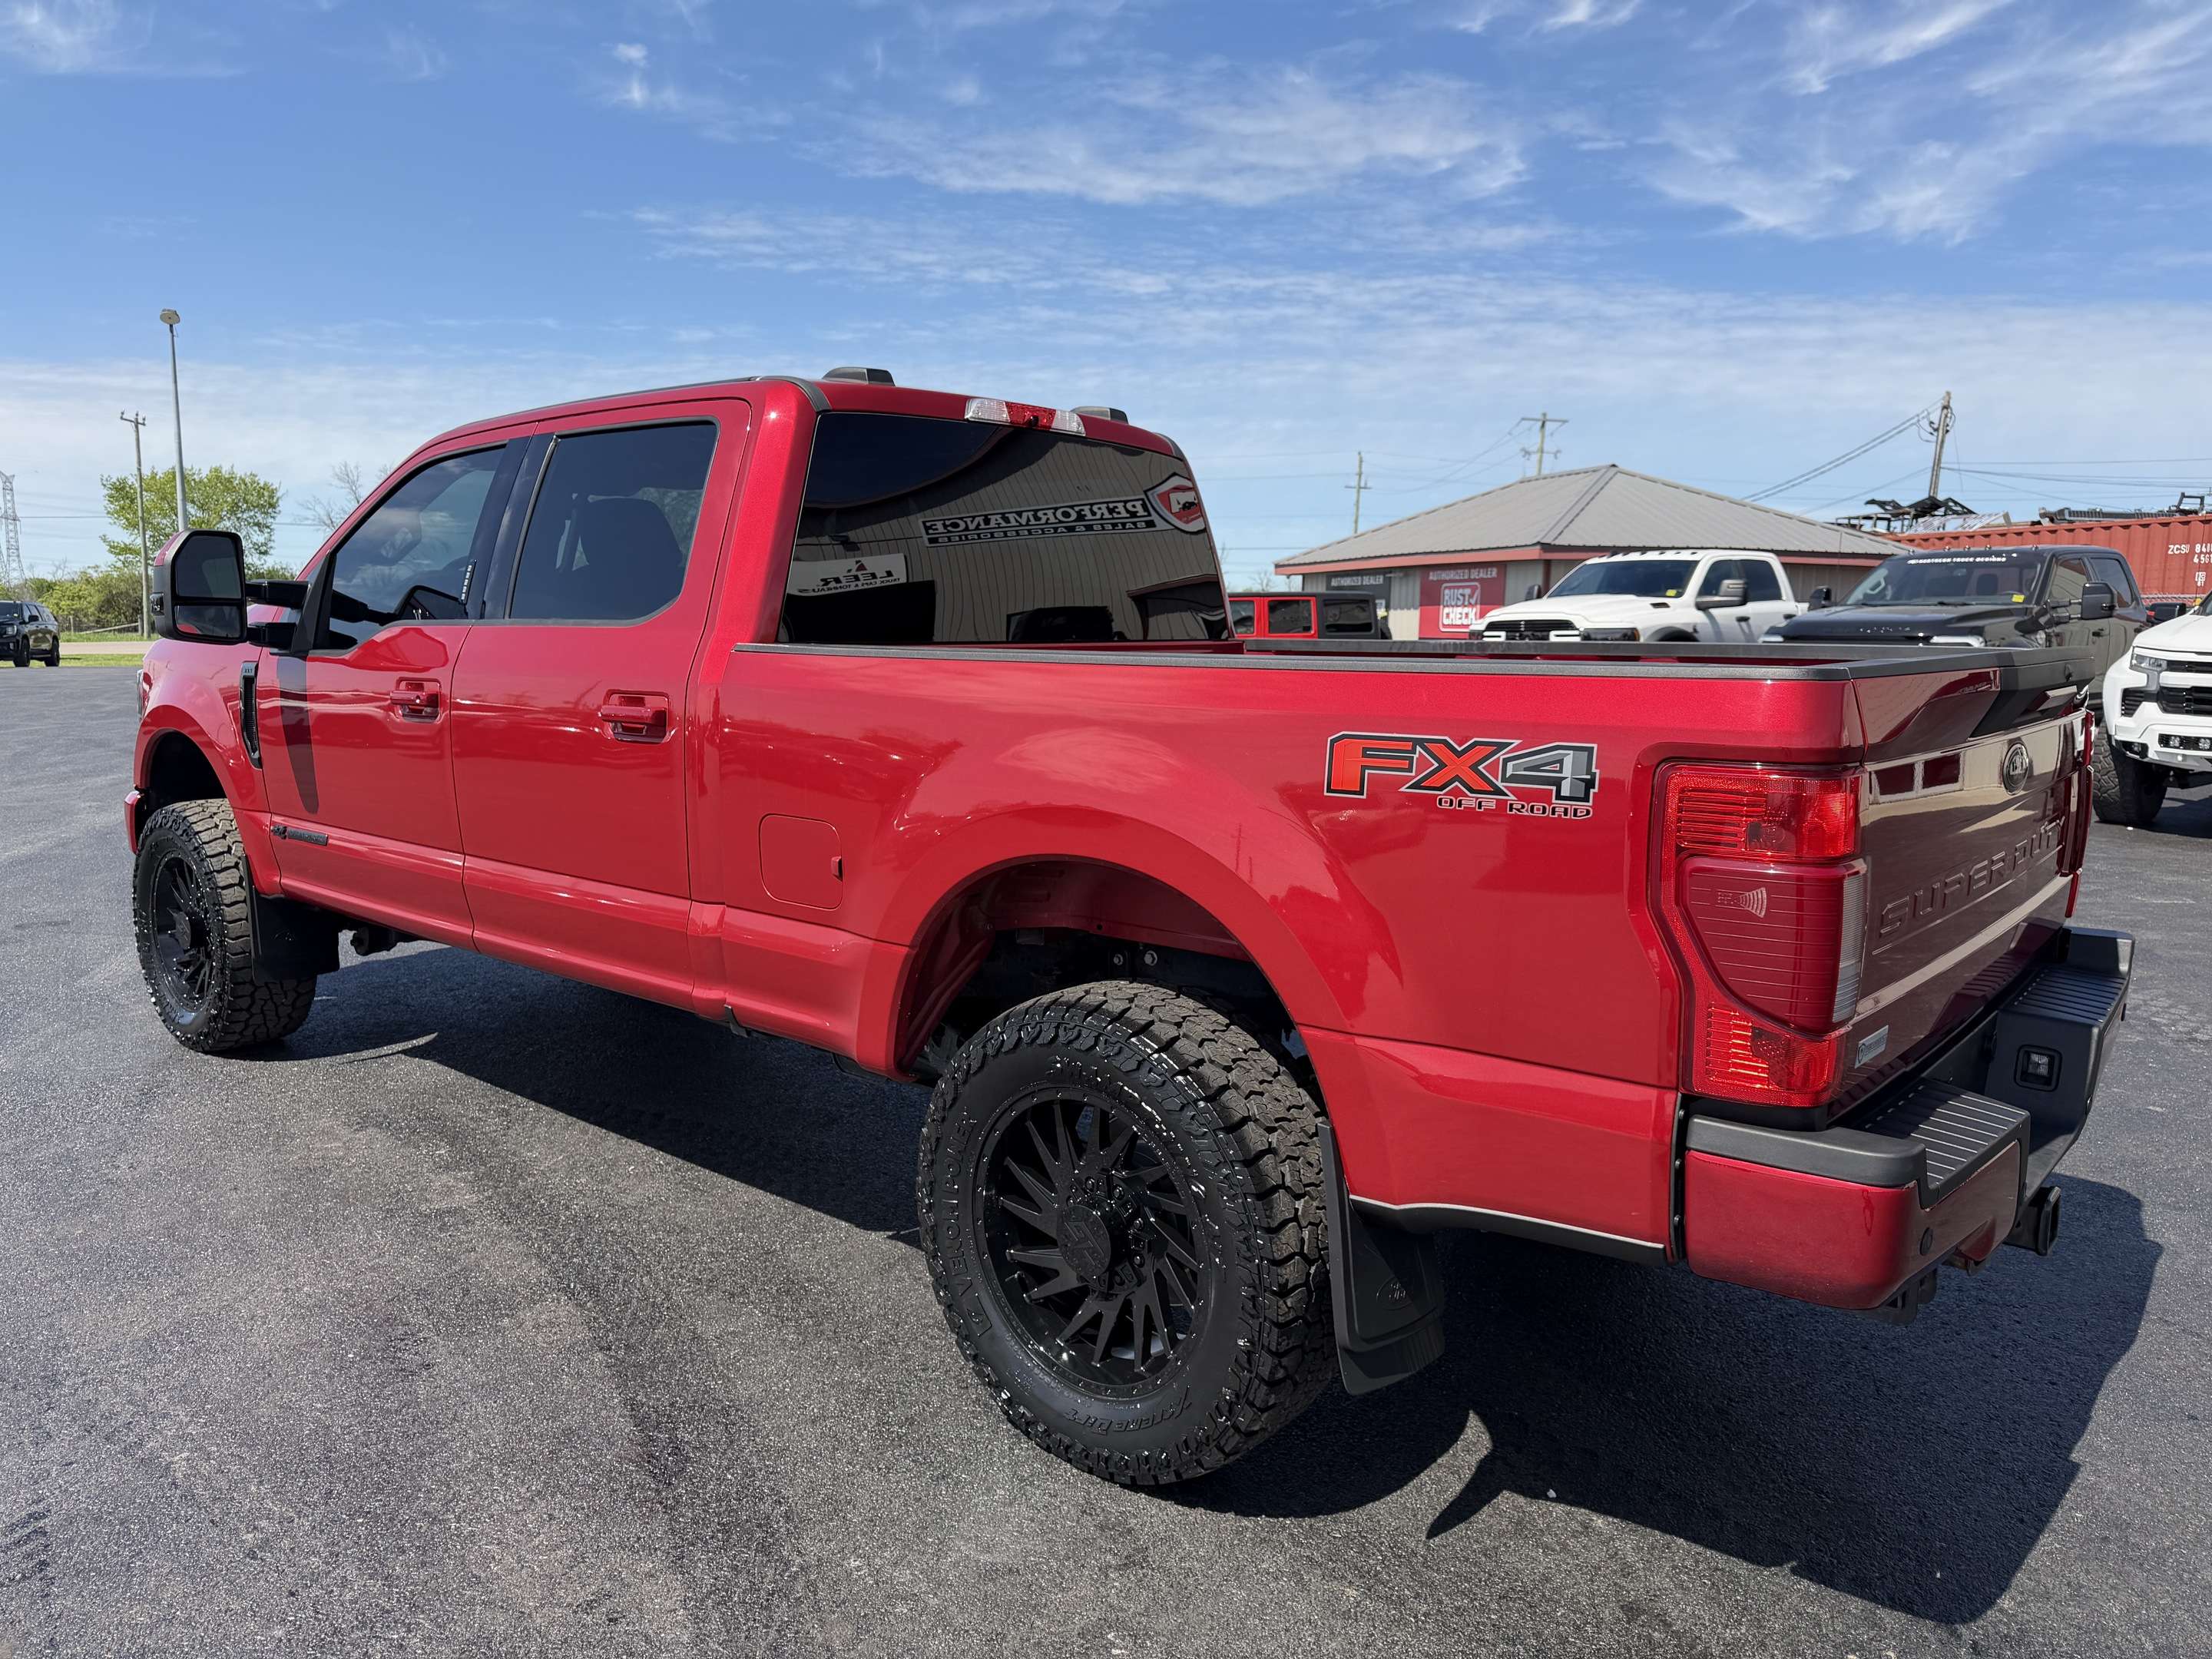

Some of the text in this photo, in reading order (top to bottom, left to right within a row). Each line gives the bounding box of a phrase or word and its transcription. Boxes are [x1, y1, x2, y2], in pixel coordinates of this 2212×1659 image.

[2167, 544, 2190, 555] ZCSU
[1331, 575, 1383, 587] AUTHORIZED DEALER
[1429, 567, 1497, 581] AUTHORIZED DEALER
[1444, 588, 1470, 606] RUST
[1443, 605, 1478, 625] CHECK
[1324, 731, 1600, 806] FX4
[1436, 795, 1593, 820] OFF ROAD
[1879, 816, 2066, 935] SUPER DUTY
[942, 1106, 978, 1296] VENOM POWER
